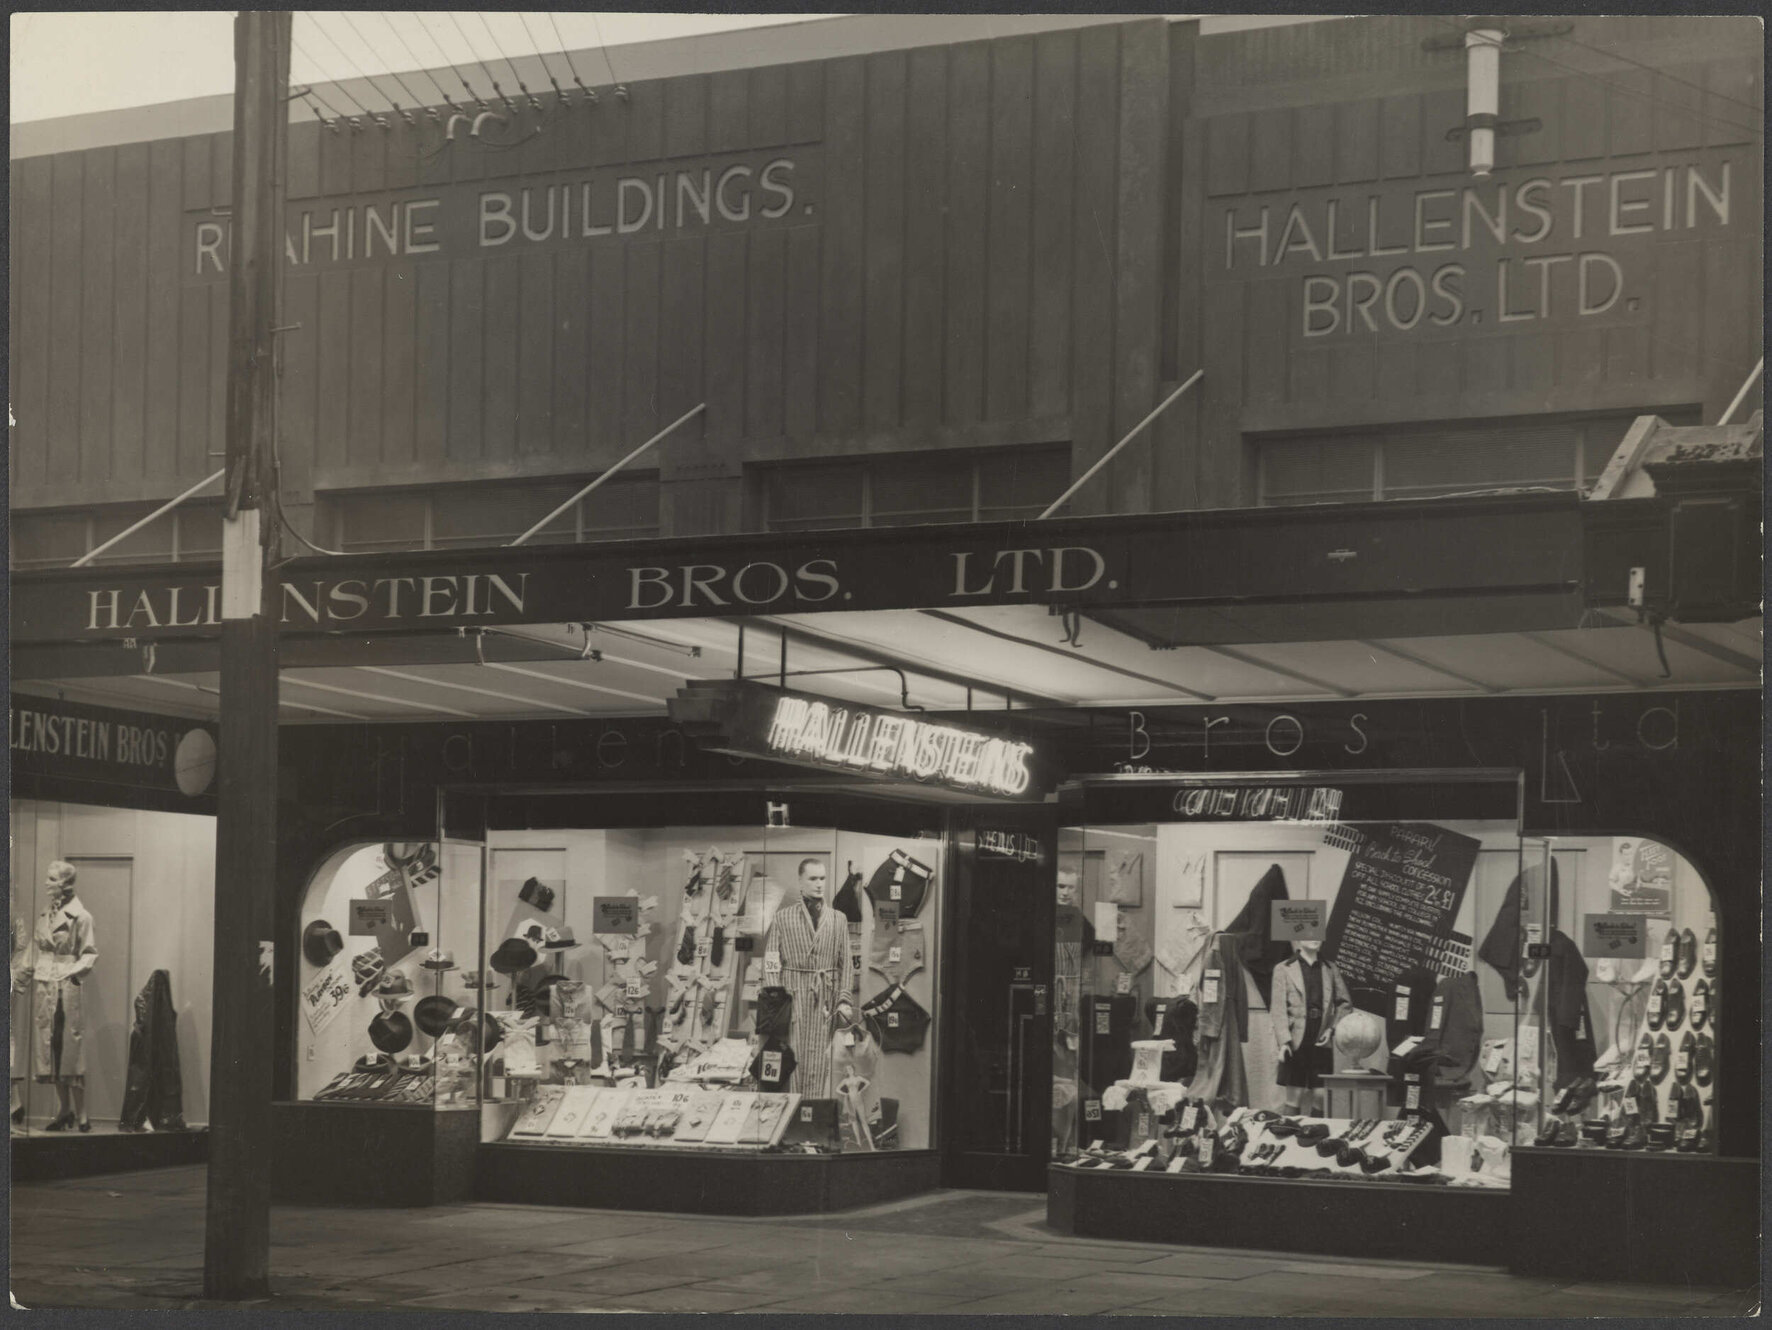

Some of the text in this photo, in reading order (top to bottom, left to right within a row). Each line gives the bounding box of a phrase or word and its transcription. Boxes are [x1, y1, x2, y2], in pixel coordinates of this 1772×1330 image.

[195, 158, 815, 275] RHINE BUILDINGS.
[1225, 161, 1732, 269] HALLENSTEIN
[1302, 254, 1642, 338] BROS. LTD.
[85, 545, 1118, 630] HALLNSTEIN BROS. LTD.
